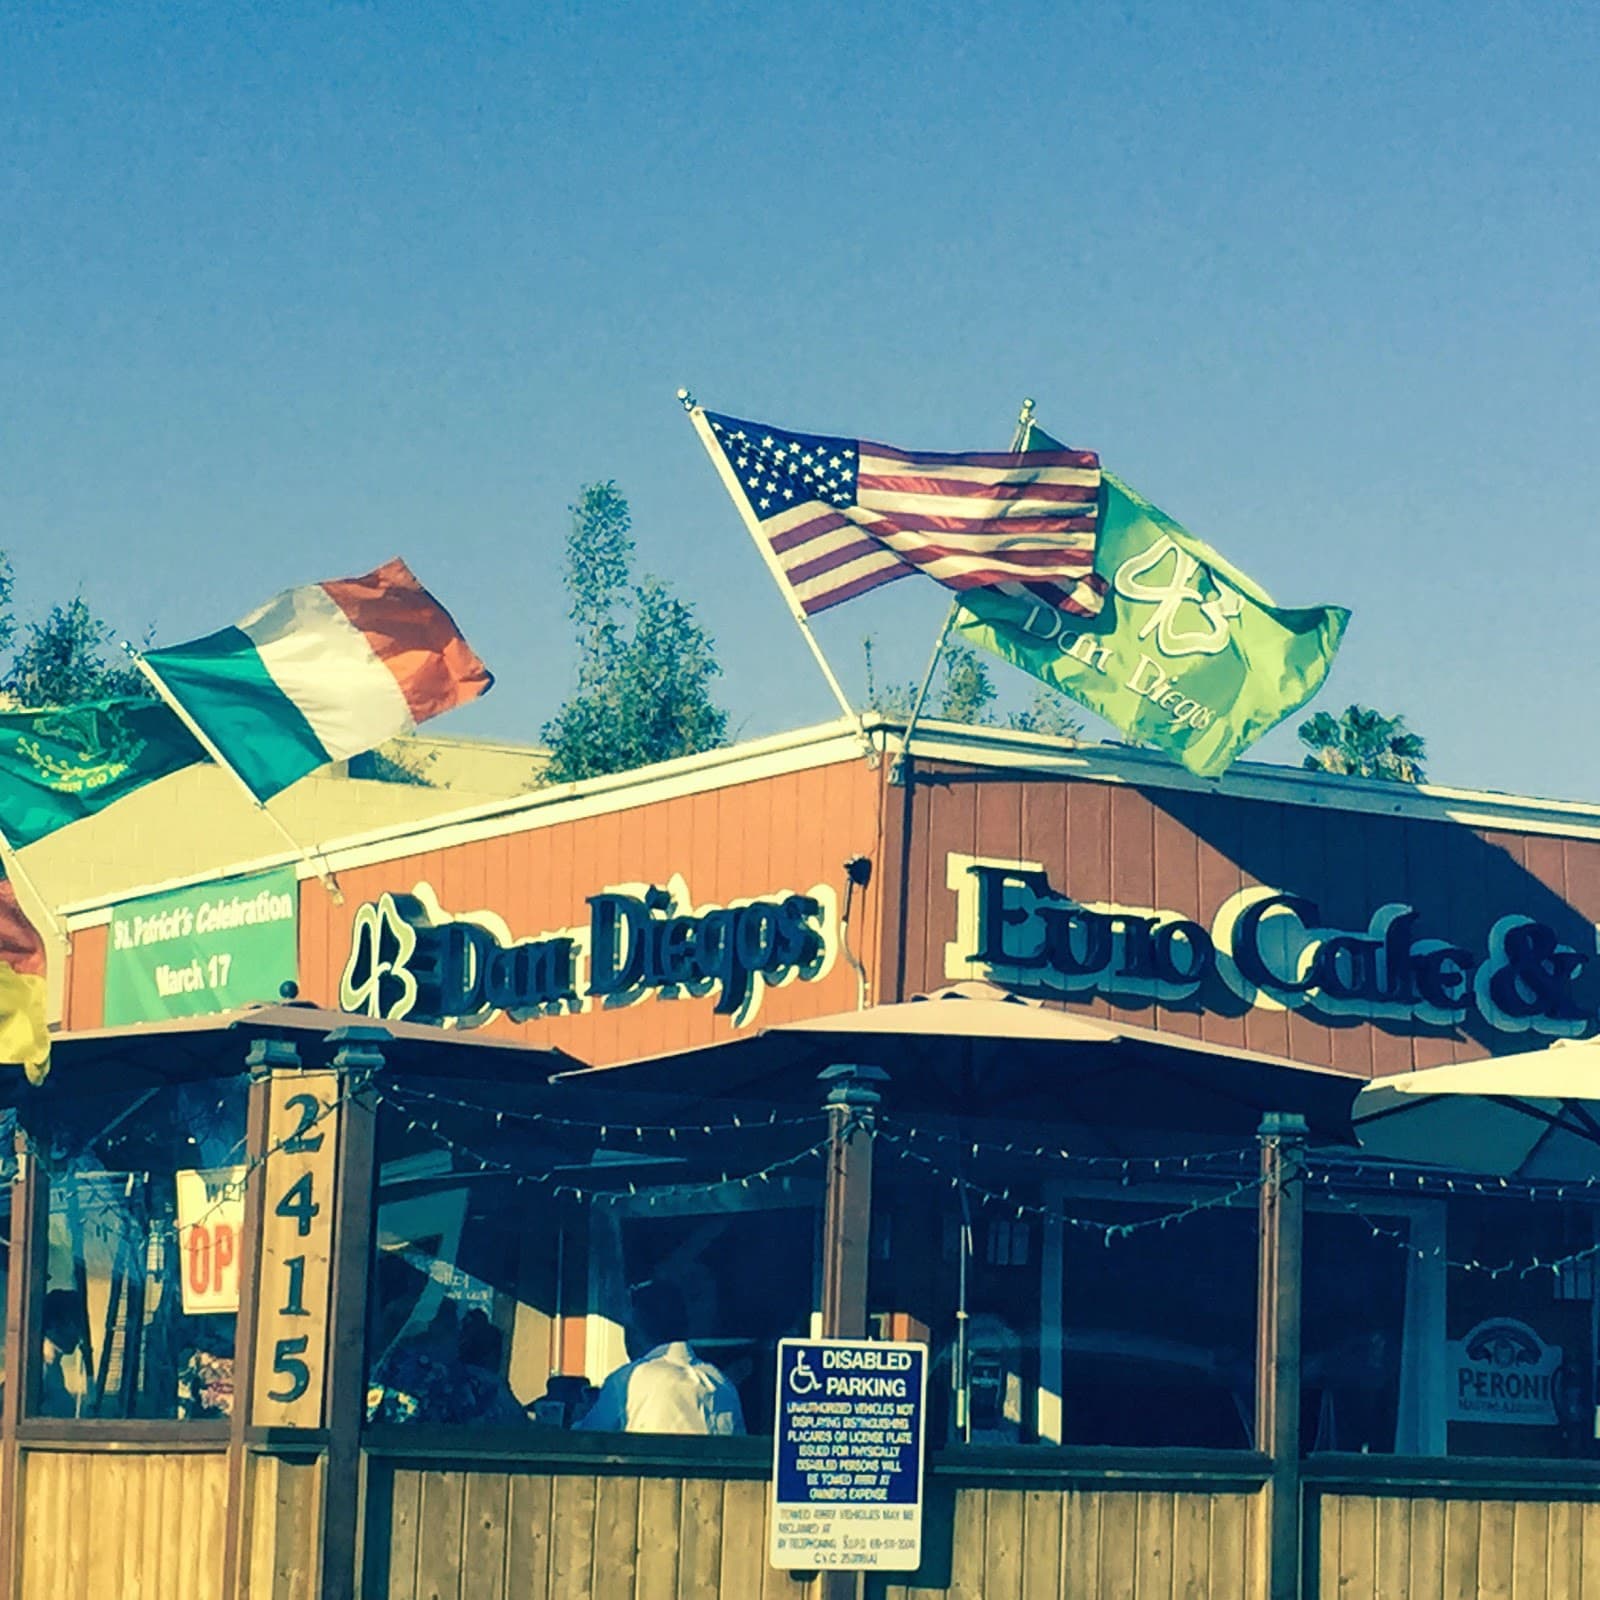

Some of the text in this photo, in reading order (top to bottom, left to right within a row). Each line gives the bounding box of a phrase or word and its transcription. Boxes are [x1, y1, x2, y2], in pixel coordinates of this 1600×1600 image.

[1022, 605, 1217, 731] Dan Diegos
[134, 906, 194, 946] Patrick's
[195, 889, 293, 934] Celebration
[440, 884, 825, 1016] Dan Diegos
[966, 866, 1590, 1019] Euro Cafe &
[155, 953, 232, 997] March 17
[189, 1222, 244, 1295] OP
[822, 1350, 912, 1371] DISABLED
[826, 1376, 907, 1397] PARKING
[896, 1403, 915, 1416] NOT
[832, 1445, 849, 1456] FOR
[834, 1430, 847, 1442] OR
